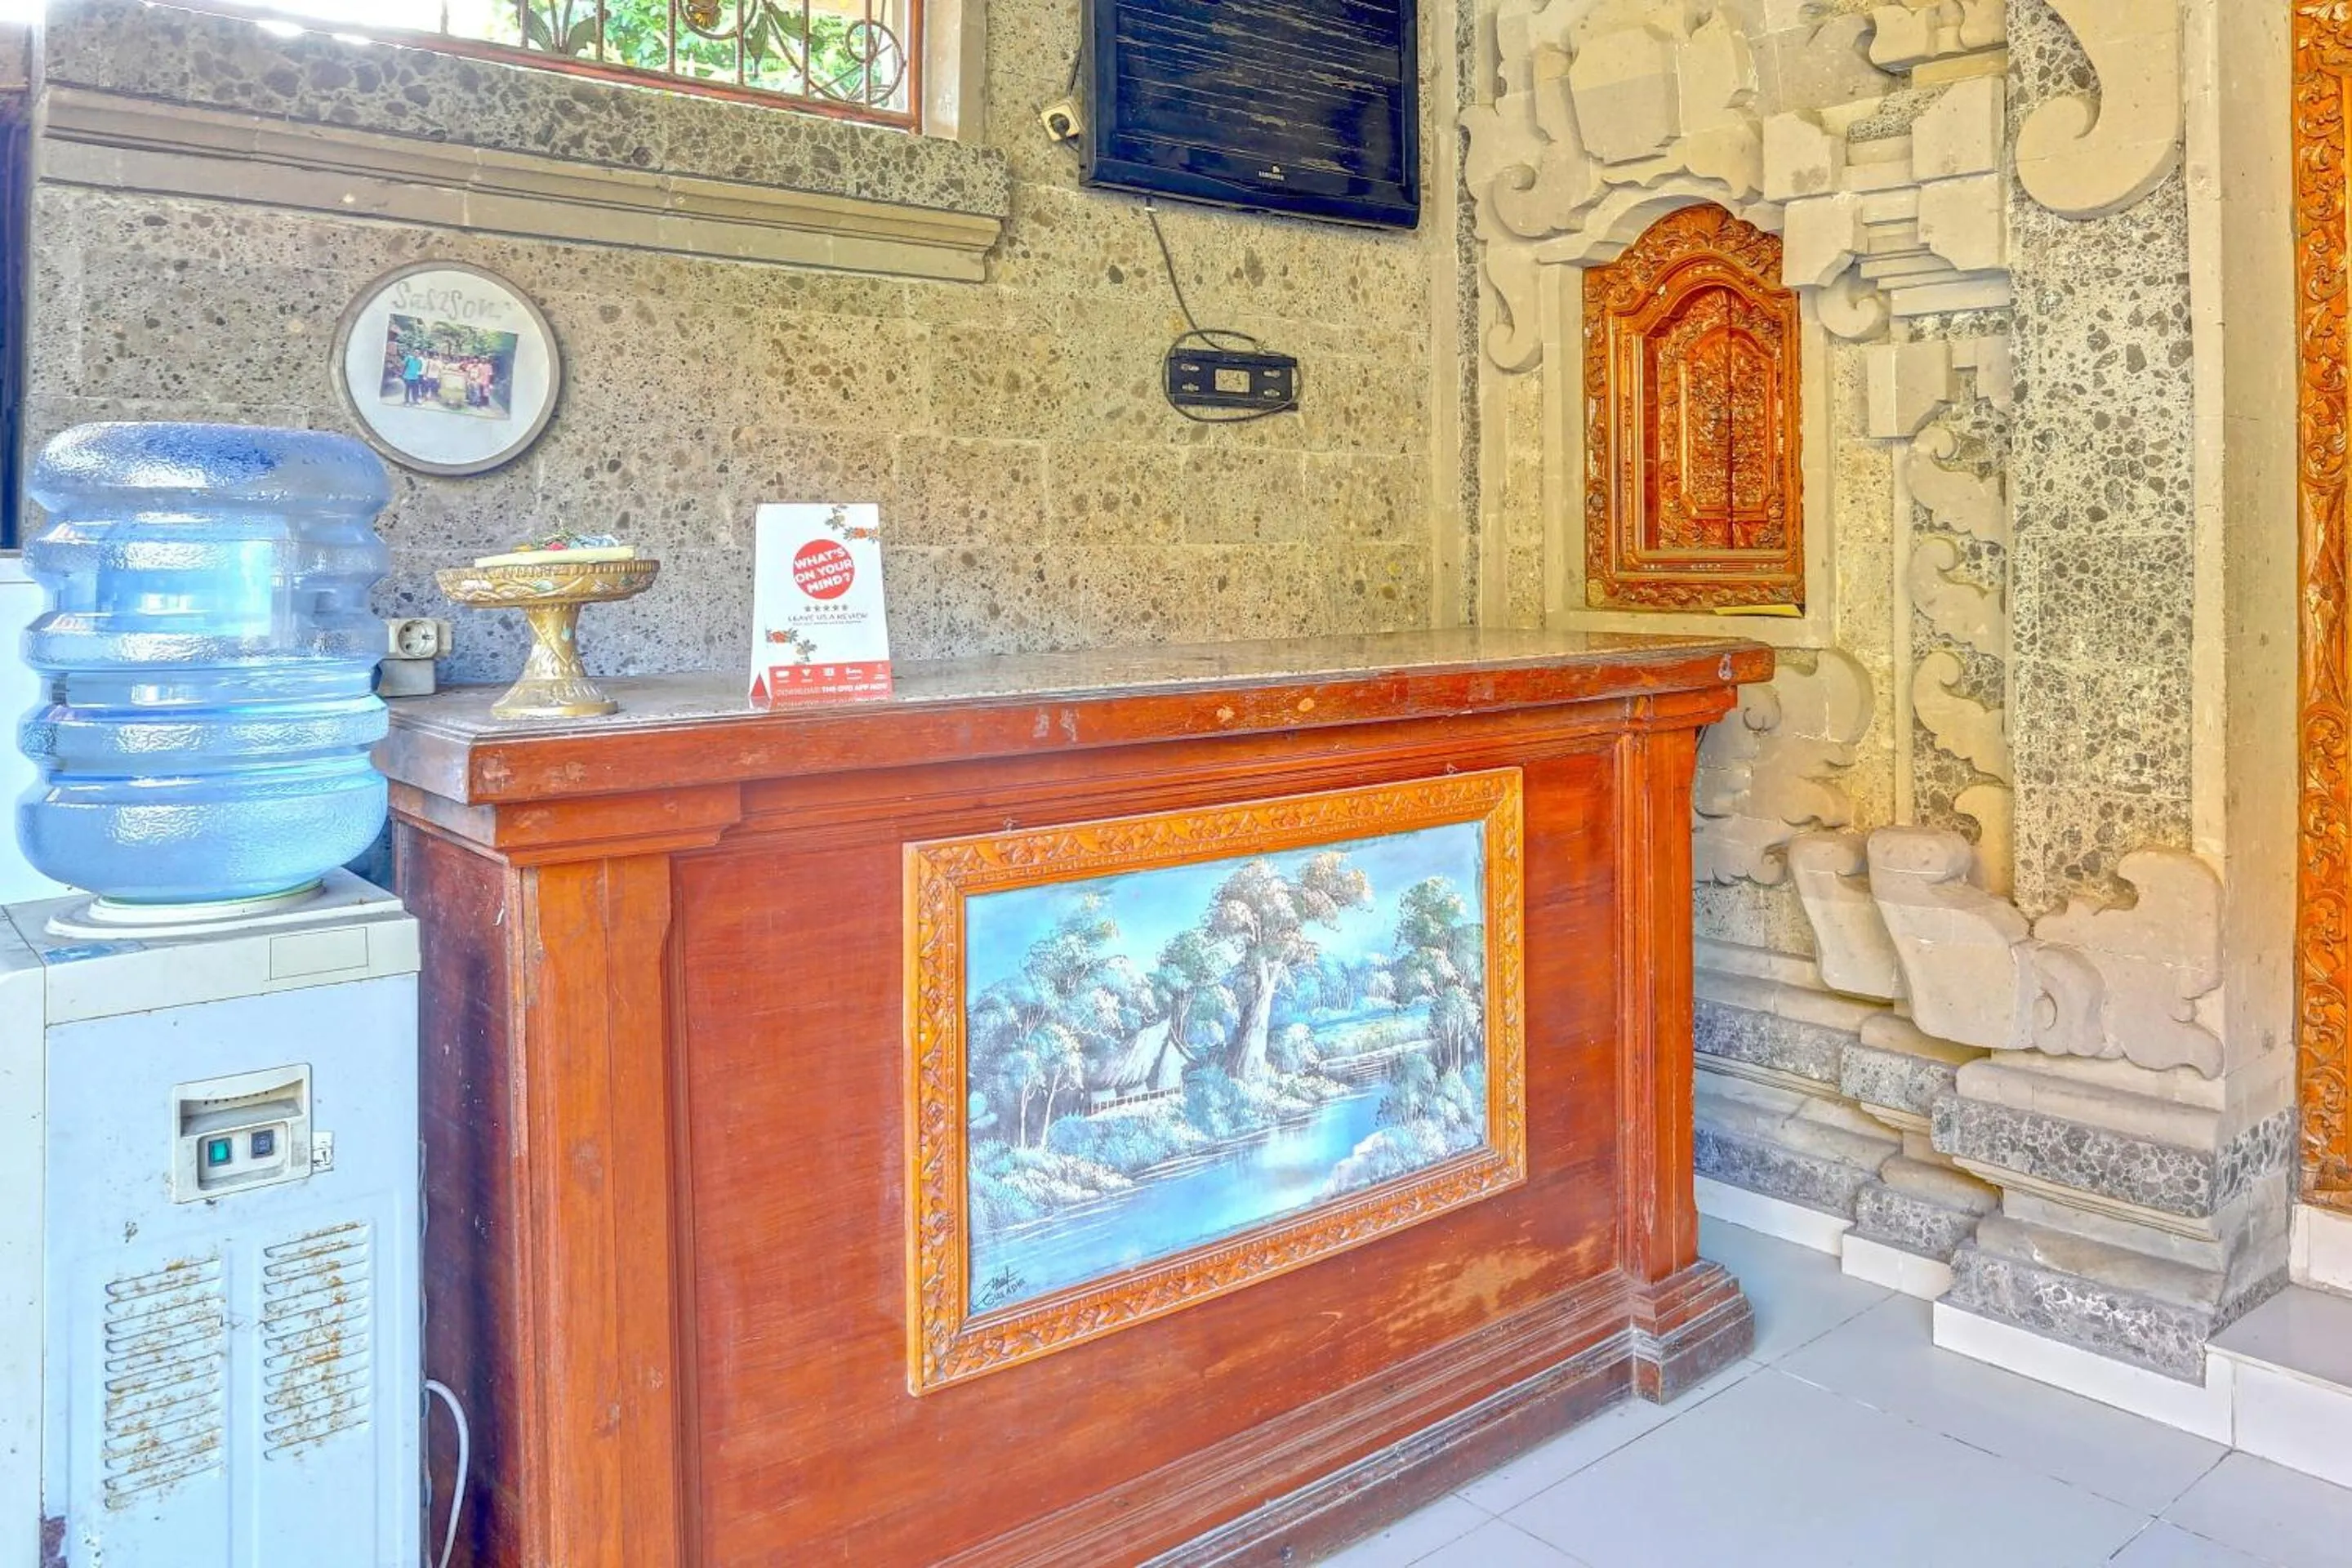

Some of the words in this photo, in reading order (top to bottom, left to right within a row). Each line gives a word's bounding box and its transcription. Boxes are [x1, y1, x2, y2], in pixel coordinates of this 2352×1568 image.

[795, 547, 845, 570] WHAT'S
[795, 569, 816, 584] ON
[817, 559, 853, 576] YOUR
[807, 572, 851, 594] MIND?
